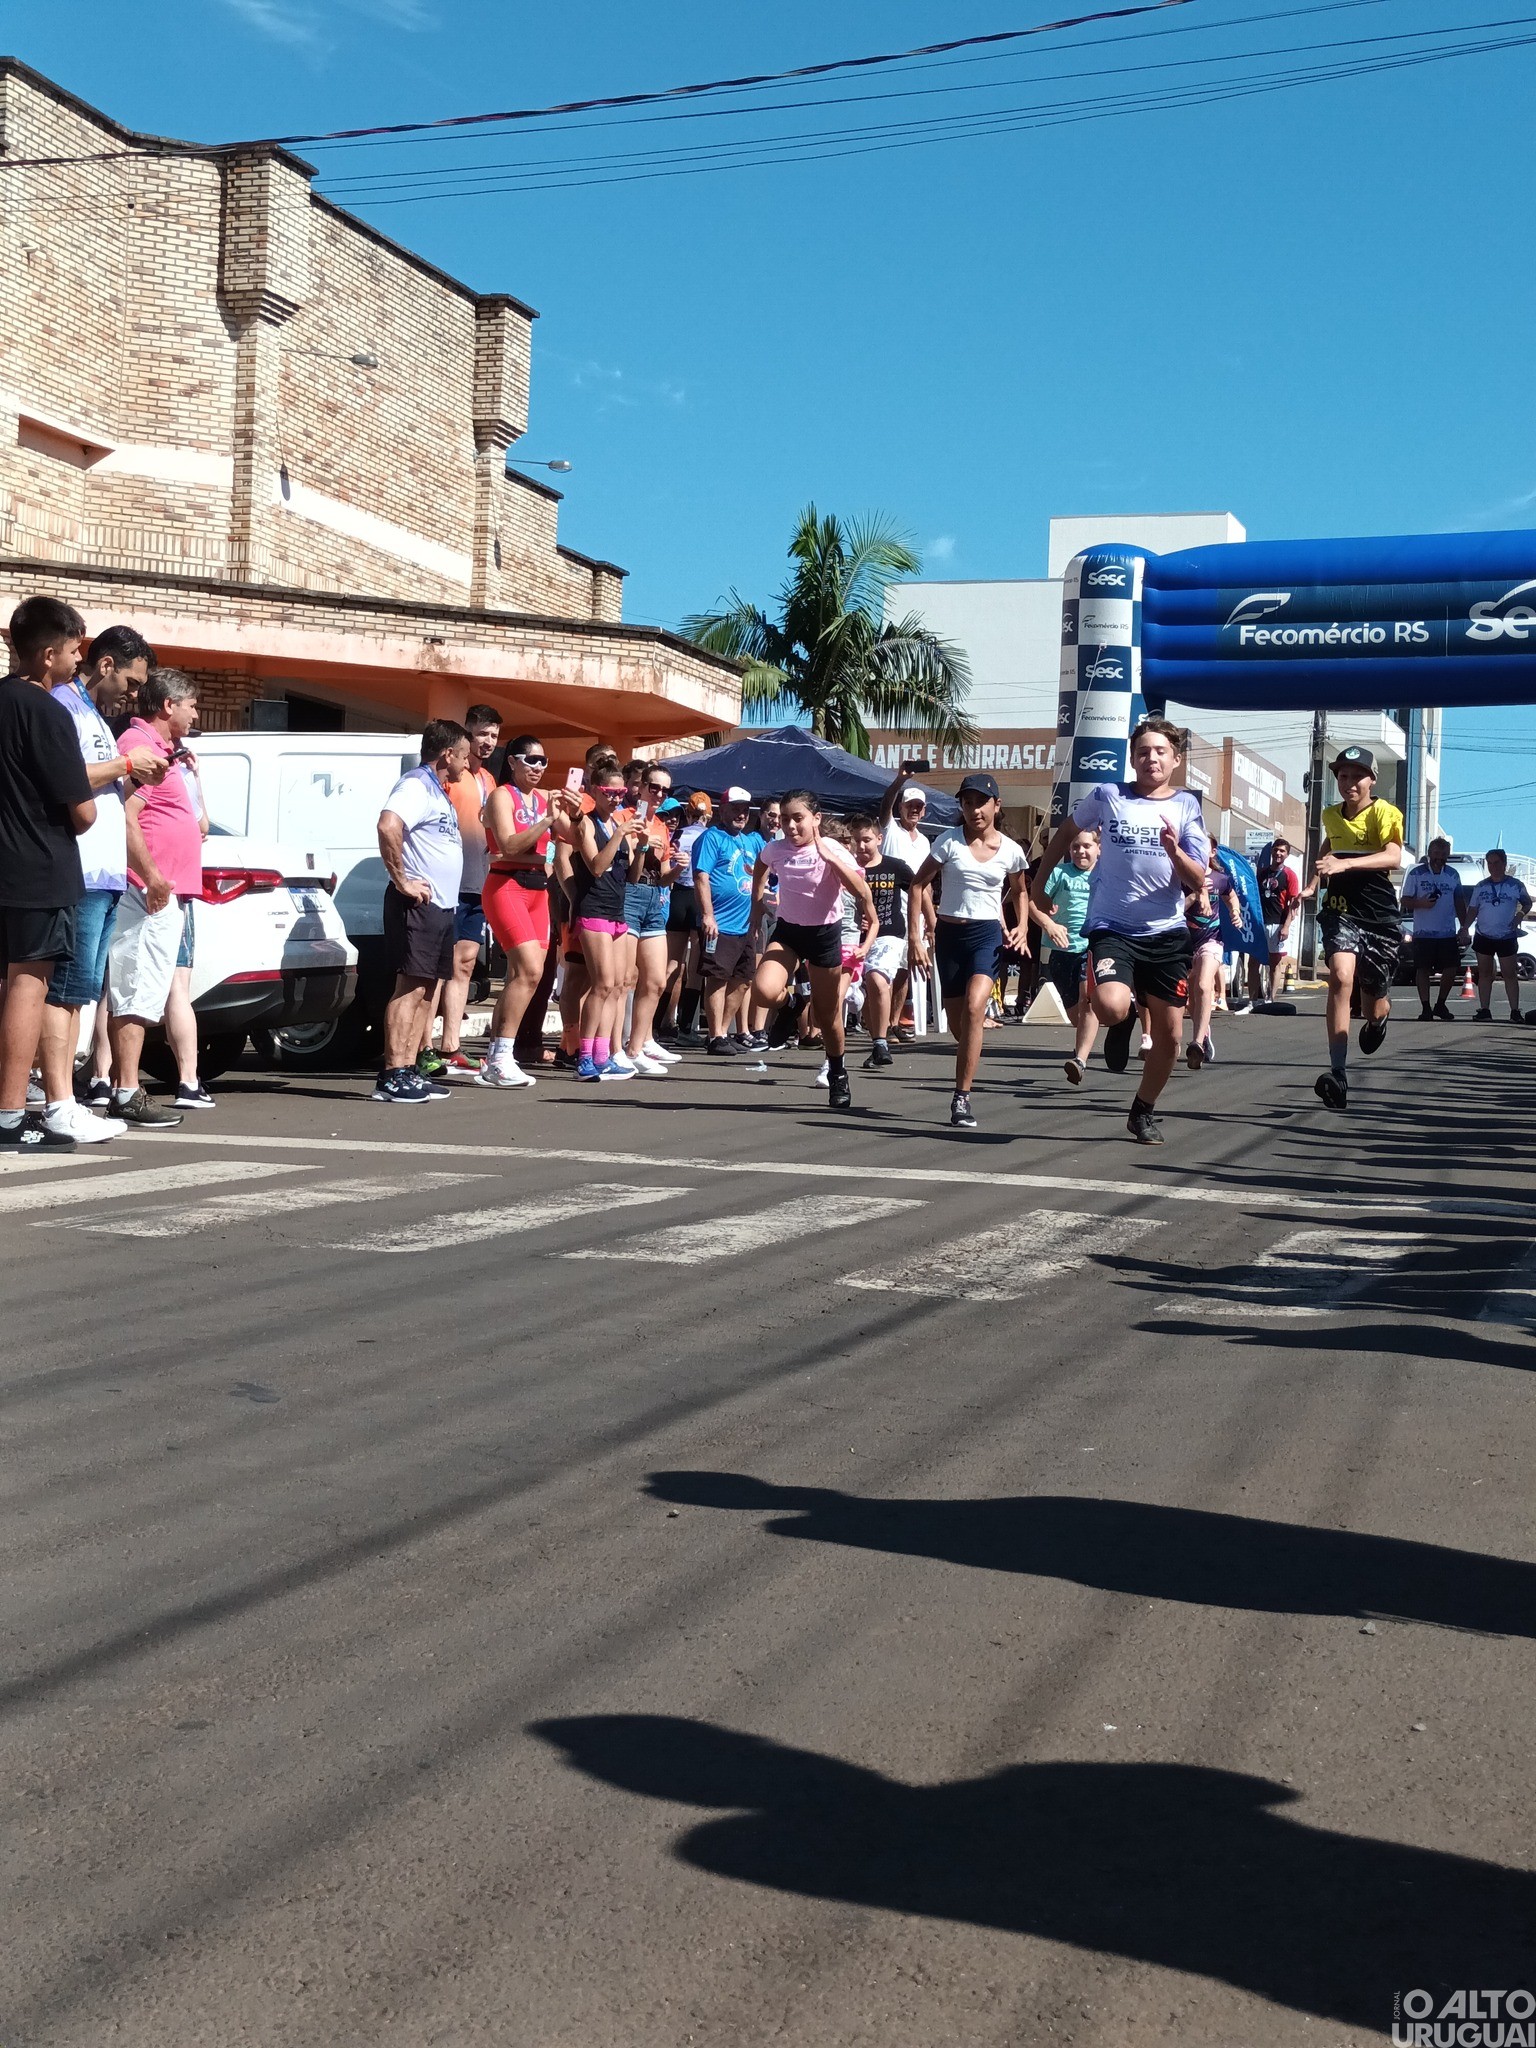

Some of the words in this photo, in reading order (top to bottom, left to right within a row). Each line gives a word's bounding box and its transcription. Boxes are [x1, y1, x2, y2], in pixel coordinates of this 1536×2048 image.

[1088, 569, 1125, 586] Sesc
[1240, 623, 1386, 645] Fecomércio
[1394, 621, 1429, 643] RS
[1085, 662, 1123, 679] Sesc
[870, 744, 922, 769] ANTE
[1079, 754, 1118, 771] Sesc
[1121, 825, 1159, 836] RÚST
[1110, 836, 1136, 845] DAS
[1124, 849, 1157, 857] AMETISTA
[865, 873, 895, 881] TION
